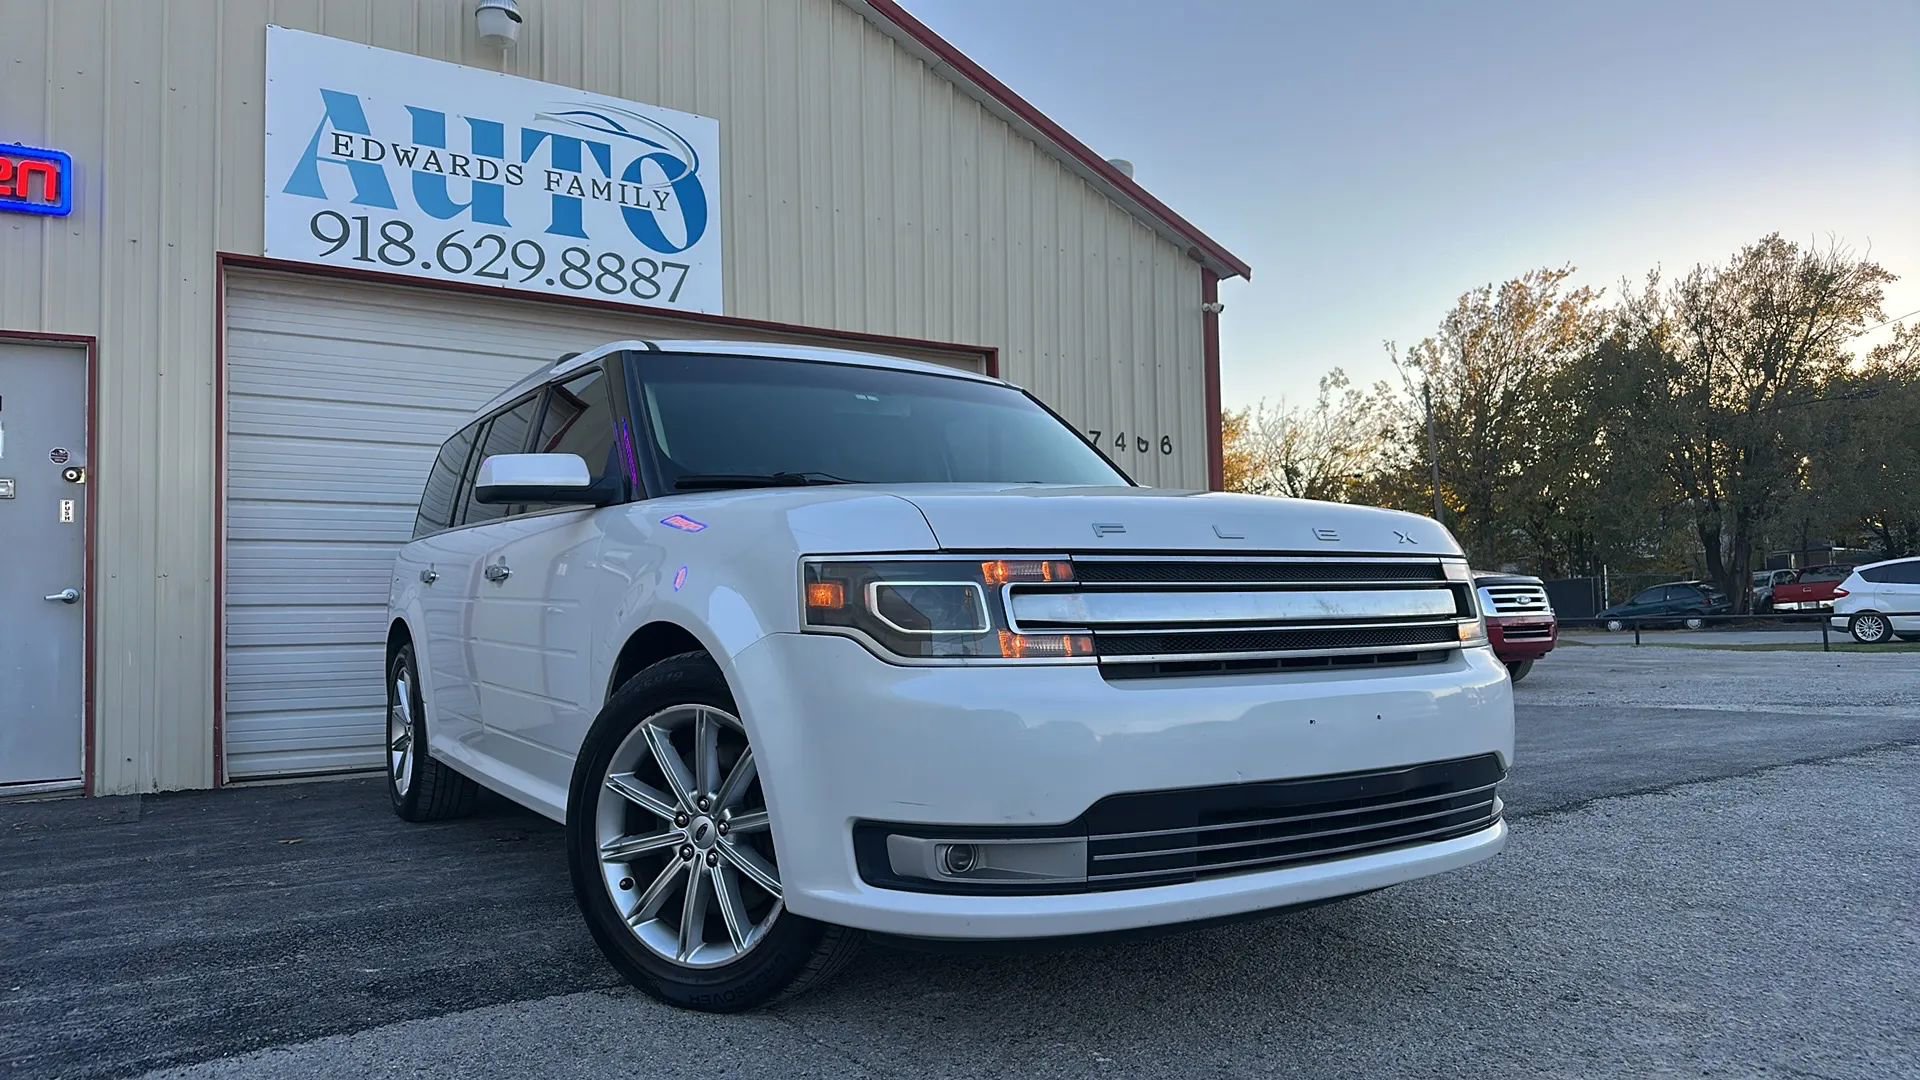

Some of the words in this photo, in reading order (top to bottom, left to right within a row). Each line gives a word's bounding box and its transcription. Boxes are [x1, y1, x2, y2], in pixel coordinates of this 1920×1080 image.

[331, 132, 524, 186] EDWARDS
[544, 170, 671, 212] FAMILY
[310, 210, 690, 304] 918.629.8887
[1092, 523, 1418, 544] FLEX
